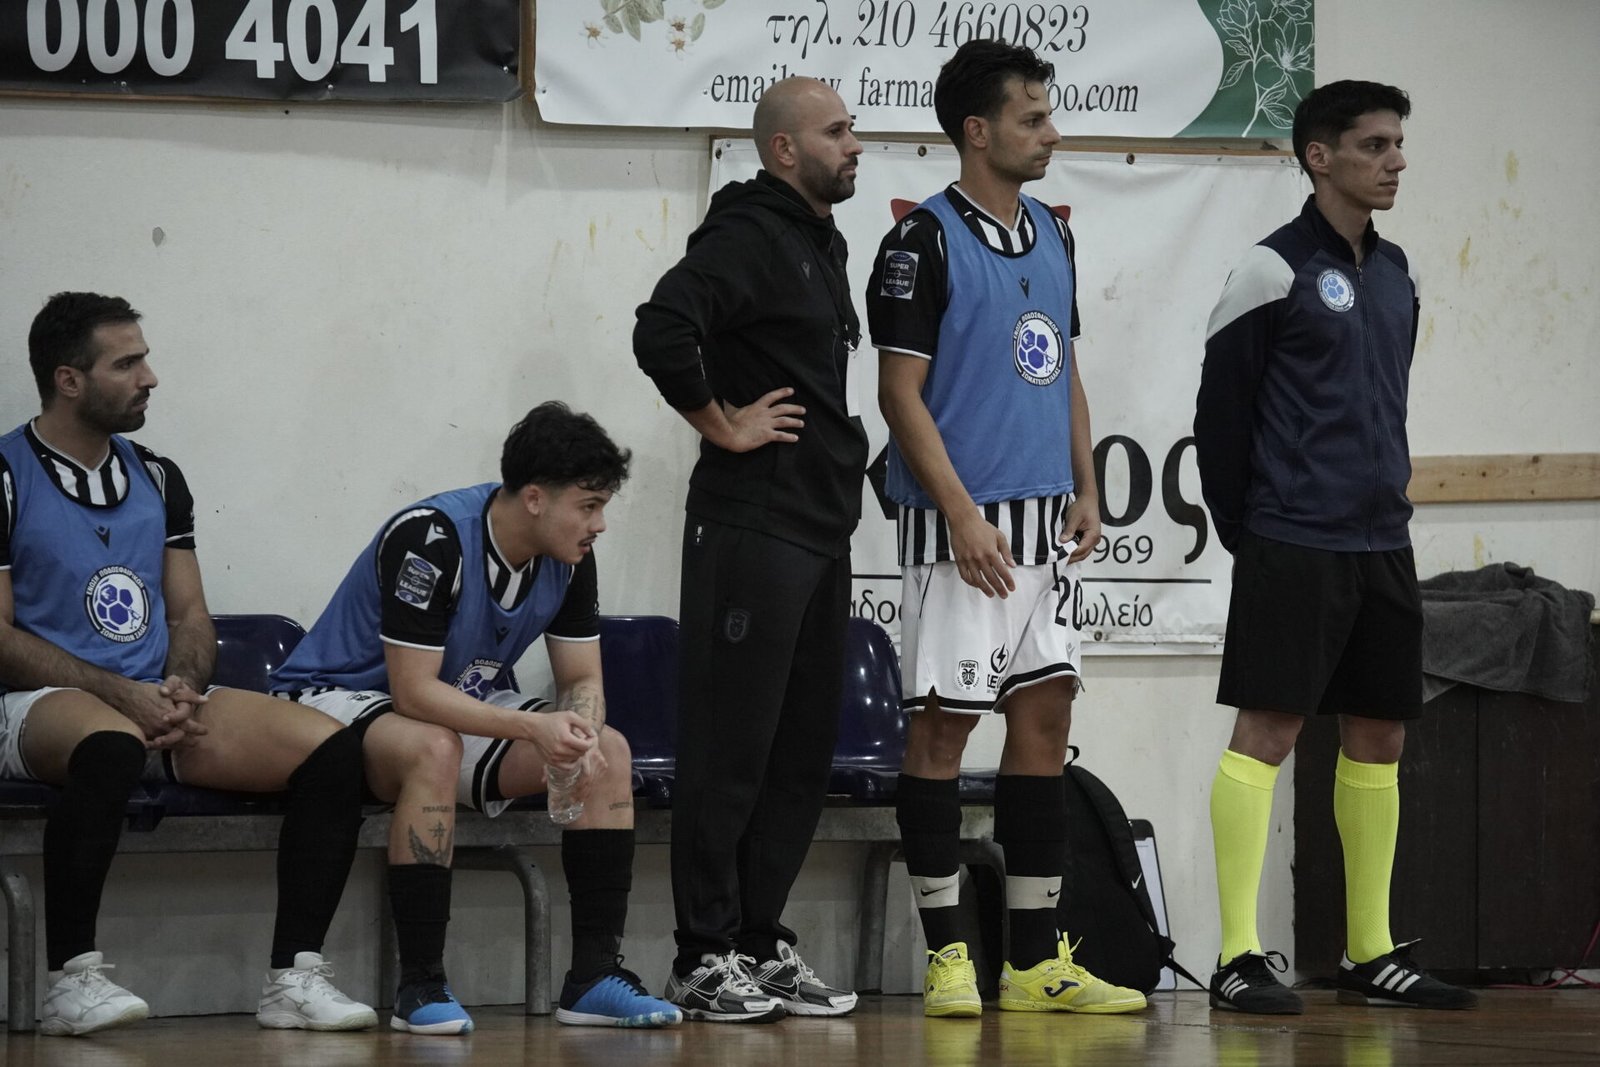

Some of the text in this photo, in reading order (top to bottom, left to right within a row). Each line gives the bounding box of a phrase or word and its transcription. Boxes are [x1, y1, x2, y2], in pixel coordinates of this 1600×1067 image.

[26, 0, 438, 84] 000 4041
[766, 0, 1090, 59] τηλ. 210 4660823
[885, 278, 910, 287] LEAGUE
[1092, 535, 1154, 565] 969
[1082, 592, 1154, 628] ωλείο
